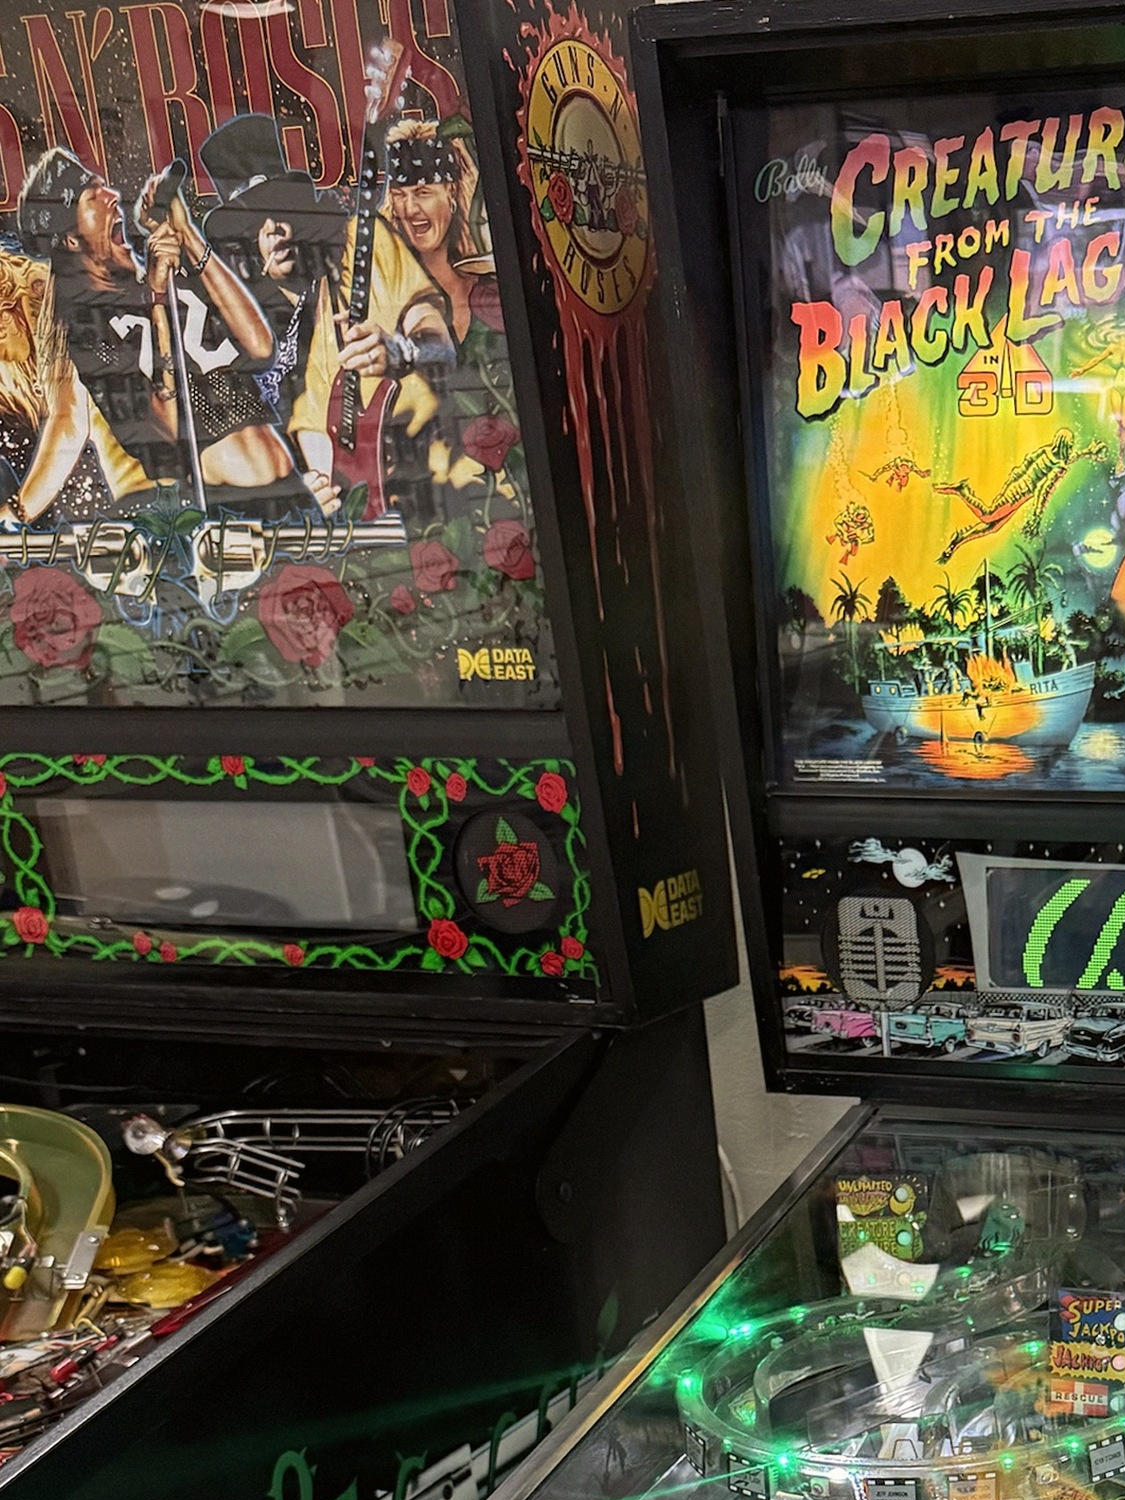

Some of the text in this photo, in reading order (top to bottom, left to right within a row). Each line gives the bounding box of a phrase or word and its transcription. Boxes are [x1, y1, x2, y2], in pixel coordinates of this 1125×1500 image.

[540, 45, 595, 105] GUNS
[754, 158, 829, 203] Bally
[907, 196, 1101, 289] FROM THE
[790, 266, 996, 421] BLACK
[983, 355, 999, 364] IN
[491, 648, 533, 664] DATA
[494, 664, 536, 681] EAST
[1028, 677, 1061, 697] RITA
[667, 868, 701, 901] DATA
[670, 892, 704, 929] EAST
[838, 1180, 893, 1193] UNLIMITED
[1068, 1299, 1122, 1324] SUPER
[1052, 1345, 1112, 1373] JACKPOT
[1055, 1391, 1105, 1404] RESCUE
